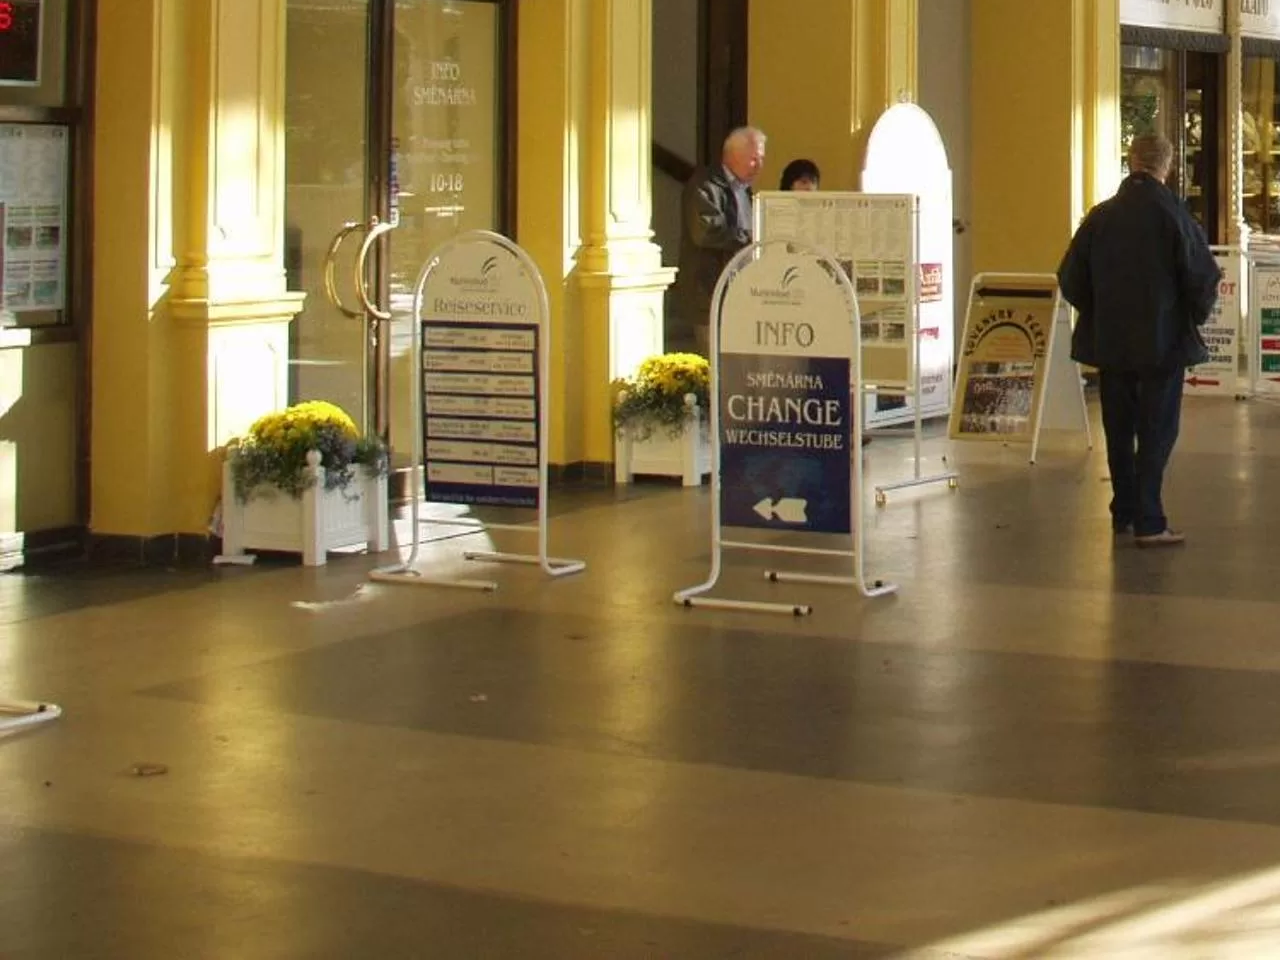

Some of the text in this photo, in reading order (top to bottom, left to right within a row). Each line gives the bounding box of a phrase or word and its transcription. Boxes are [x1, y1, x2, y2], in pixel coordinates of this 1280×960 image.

[755, 320, 815, 348] INFO
[727, 394, 842, 426] CHANGE
[725, 428, 844, 451] WECHSELSTUBE
